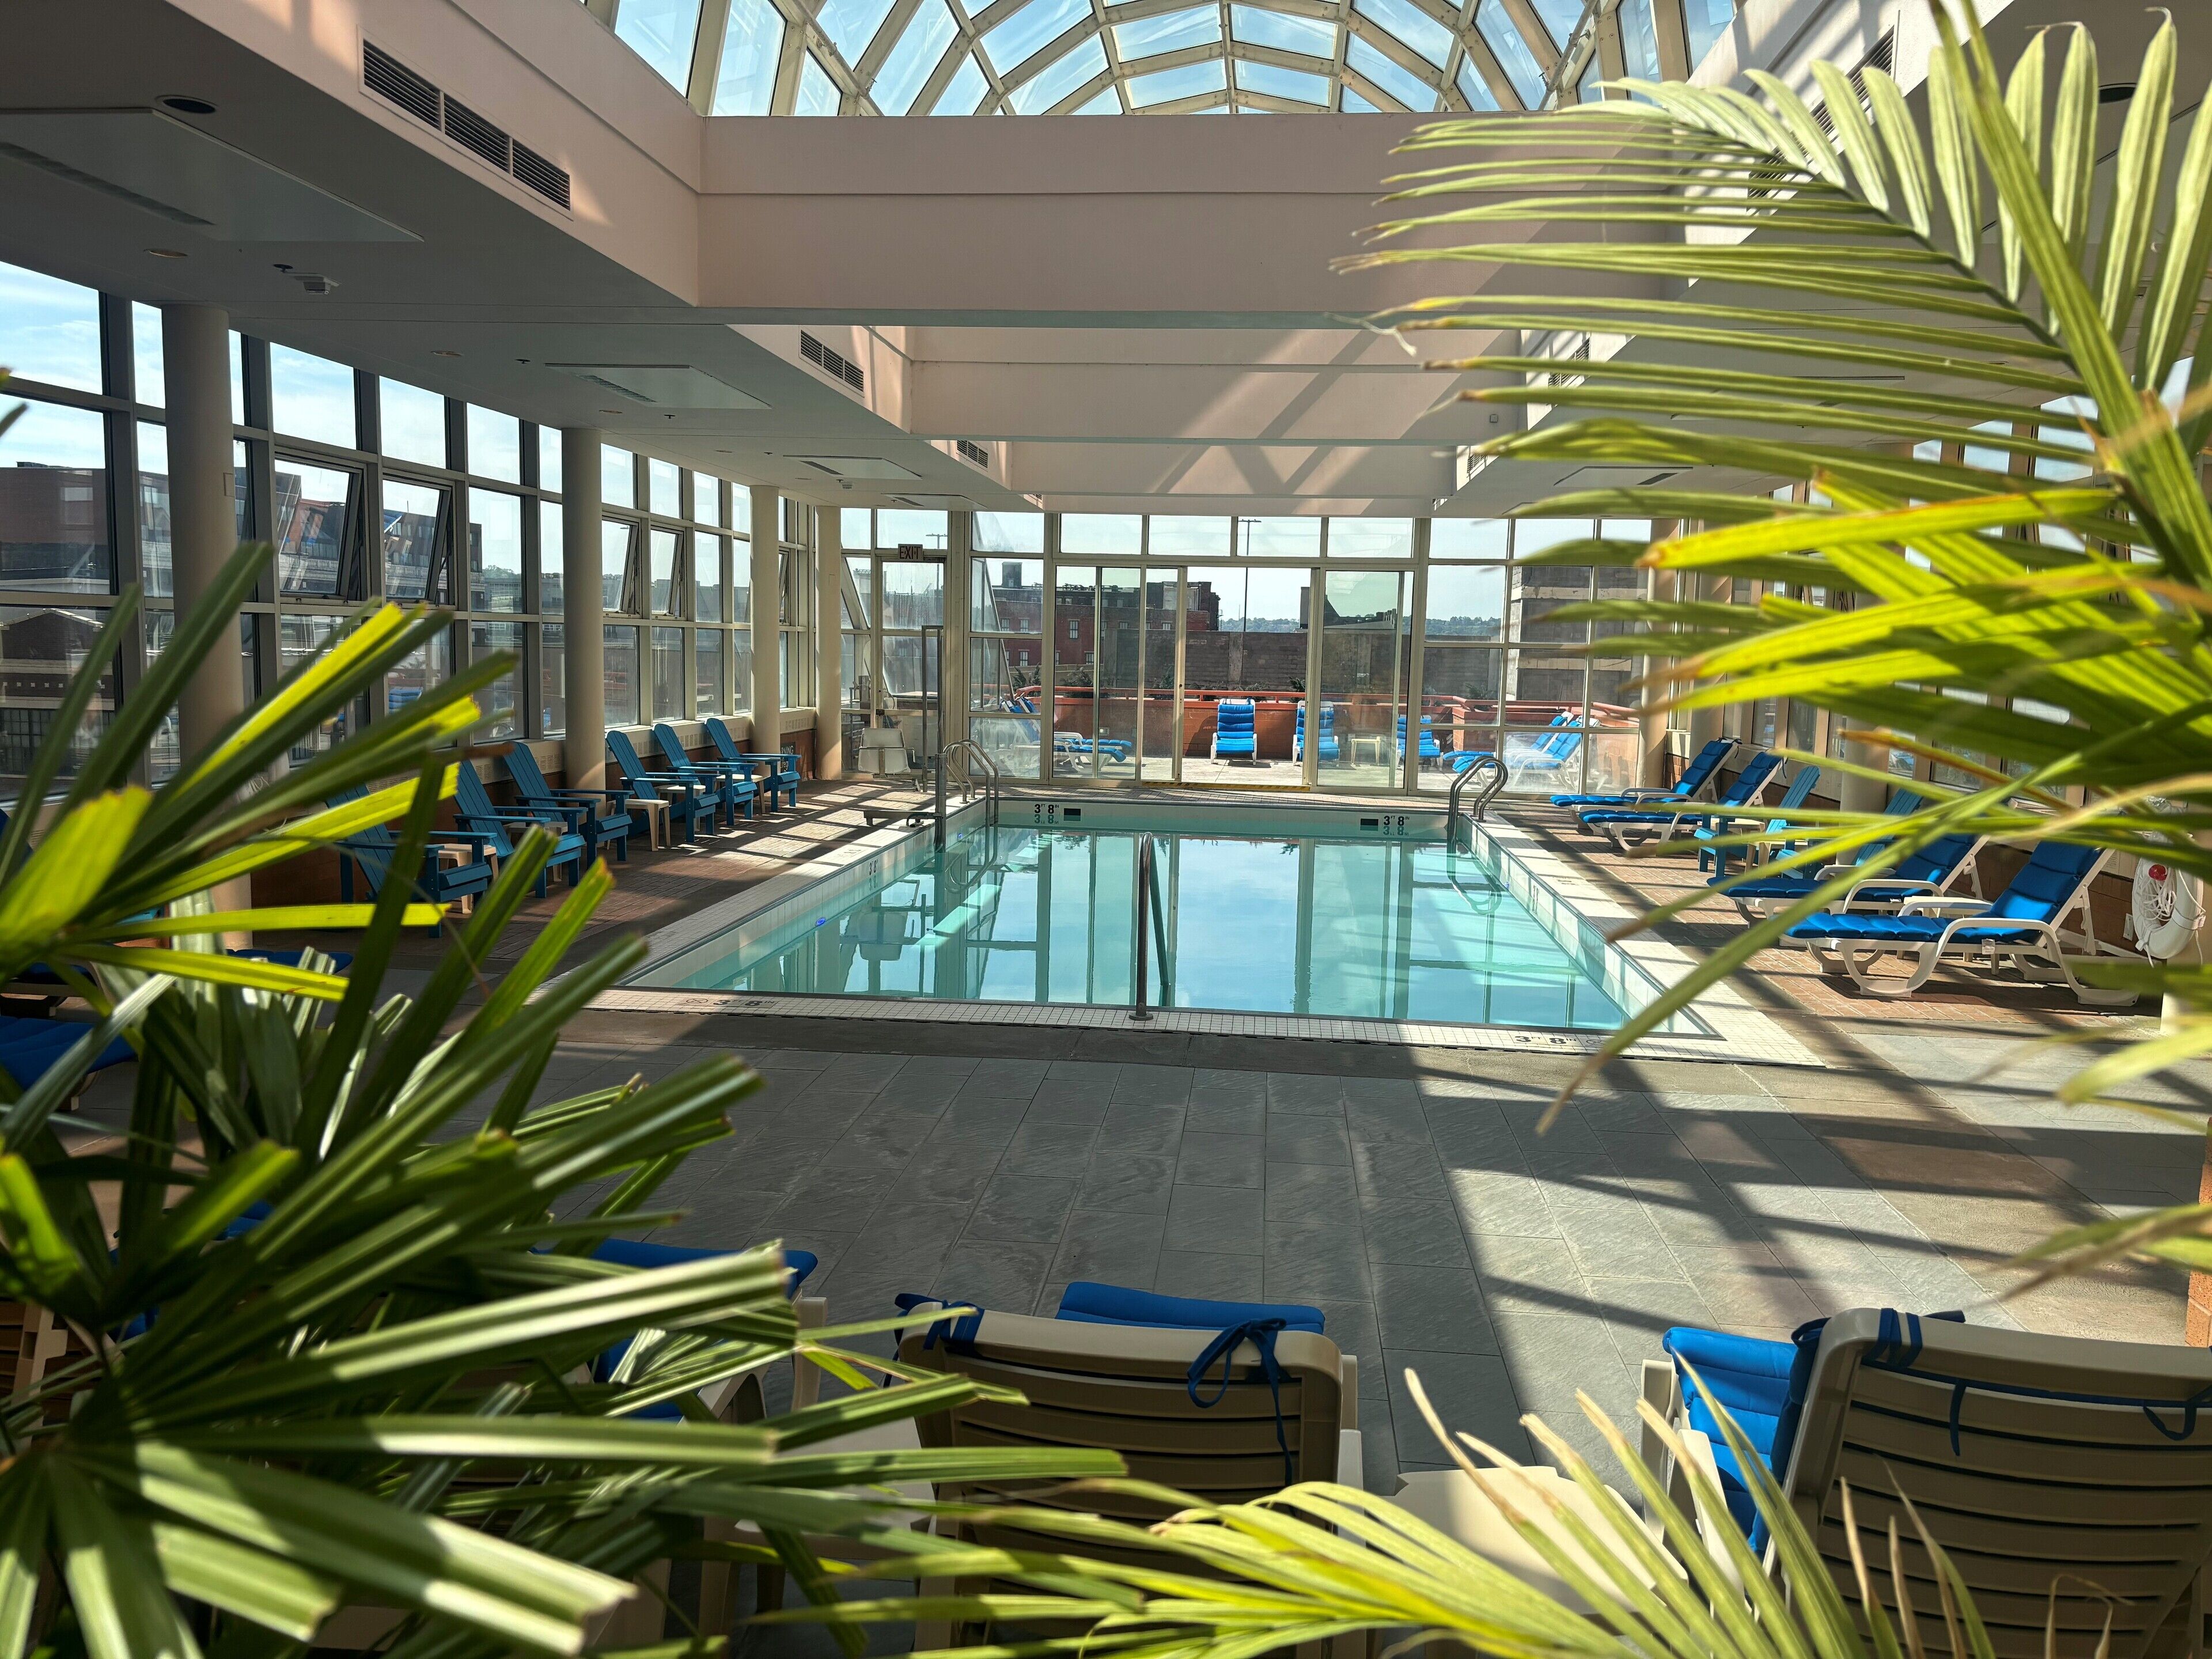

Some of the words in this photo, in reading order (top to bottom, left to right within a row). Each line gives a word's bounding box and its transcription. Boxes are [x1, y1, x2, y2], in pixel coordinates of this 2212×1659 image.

[900, 546, 921, 559] EXIT
[1035, 804, 1040, 813] 3
[1048, 805, 1054, 814] 8
[1384, 816, 1390, 825] 3
[1397, 816, 1404, 825] 8
